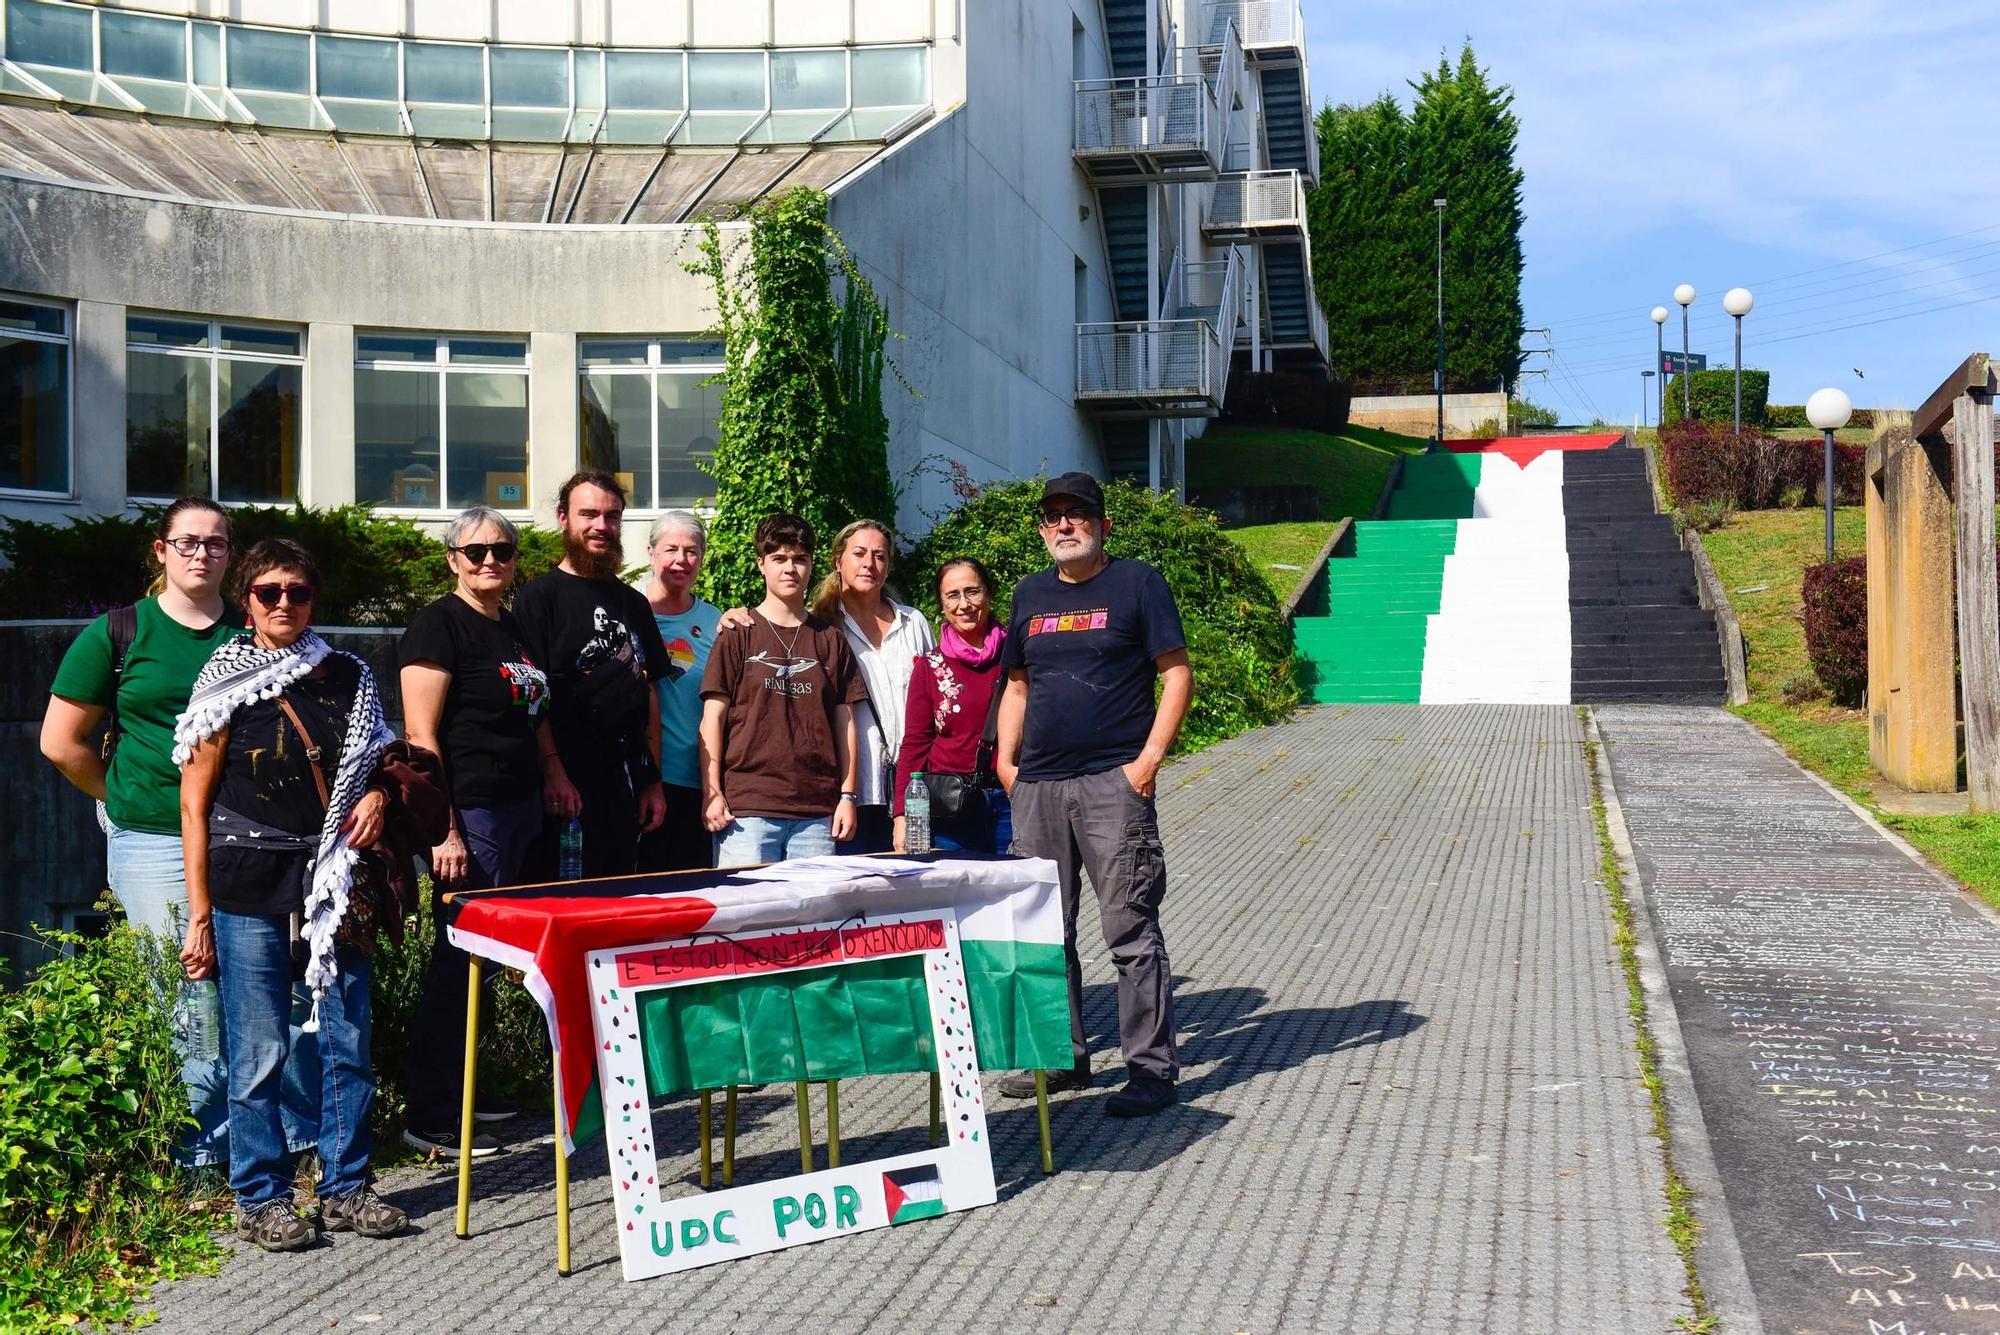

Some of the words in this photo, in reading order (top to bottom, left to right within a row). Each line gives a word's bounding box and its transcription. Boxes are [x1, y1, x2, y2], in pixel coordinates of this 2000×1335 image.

[503, 485, 515, 495] 35
[625, 959, 641, 982] E
[652, 948, 729, 976] ESTOU
[742, 938, 834, 971] CONTRA
[844, 935, 857, 956] O
[861, 922, 943, 956] XENOCIDIO
[1750, 1060, 1892, 1075] Mahmoud
[1778, 1108, 1882, 1122] Sabah
[1904, 1114, 1984, 1126] Raed
[1796, 1134, 1932, 1151] Ayman
[1827, 1169, 2000, 1190] 2024-0
[1816, 1183, 1985, 1210] Naser
[650, 1209, 738, 1257] UDC
[772, 1184, 863, 1238] POR
[1827, 1204, 1975, 1227] Naser
[1796, 1252, 1917, 1284] Taj
